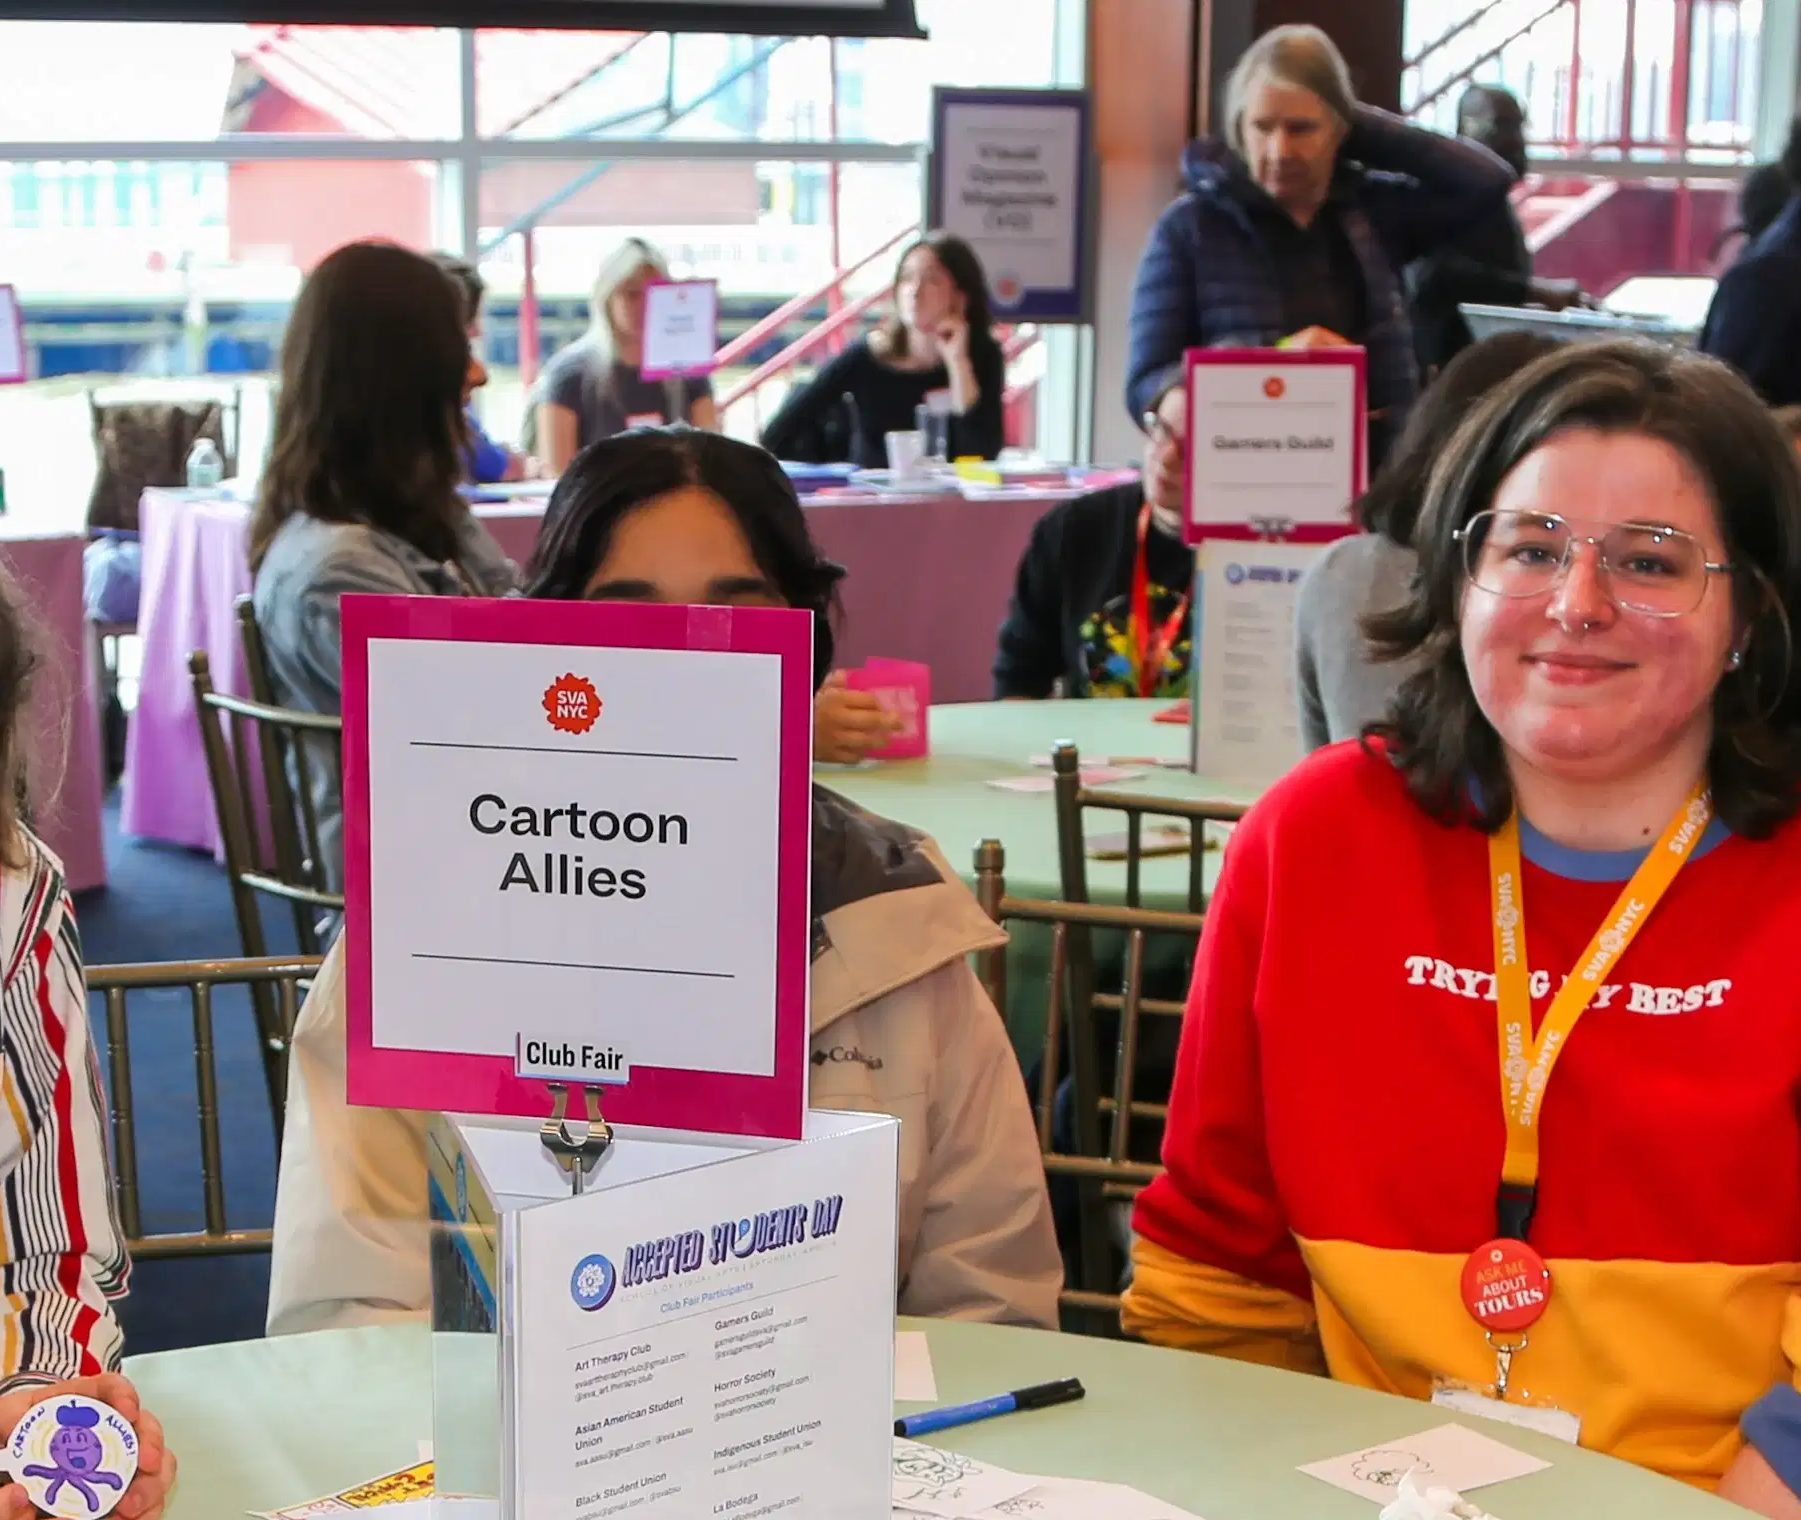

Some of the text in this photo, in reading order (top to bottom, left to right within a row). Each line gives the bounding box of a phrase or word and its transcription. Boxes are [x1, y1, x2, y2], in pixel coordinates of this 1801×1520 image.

[557, 691, 588, 705] SVA
[557, 705, 588, 720] NYC
[469, 793, 689, 845] Cartoon
[1668, 820, 1696, 855] SVA
[500, 852, 647, 900] Allies
[1498, 872, 1513, 908] SVA
[1582, 897, 1646, 982] SVA NYC
[1404, 955, 1551, 1002] TRYIG
[1626, 978, 1733, 1015] BEST
[526, 1041, 624, 1070] Club Fair
[1519, 1030, 1562, 1127] SVA NYC
[622, 1229, 705, 1287] ACCEPTED
[811, 1194, 844, 1239] DAY
[1476, 1267, 1504, 1284] ASK
[1483, 1275, 1528, 1298] ABOUT
[660, 1281, 754, 1313] Club Fair Participants
[1474, 1286, 1544, 1317] TOURS
[714, 1306, 774, 1331] Gamers Guild
[575, 1344, 651, 1372] Art Therapy Club
[714, 1368, 776, 1392] Horror Society
[575, 1396, 684, 1436] Asian American Student
[575, 1436, 603, 1451] Union
[713, 1420, 822, 1460] Indigenous Student Union
[575, 1472, 667, 1508] Black Student Union
[713, 1493, 759, 1514] La Bodega
